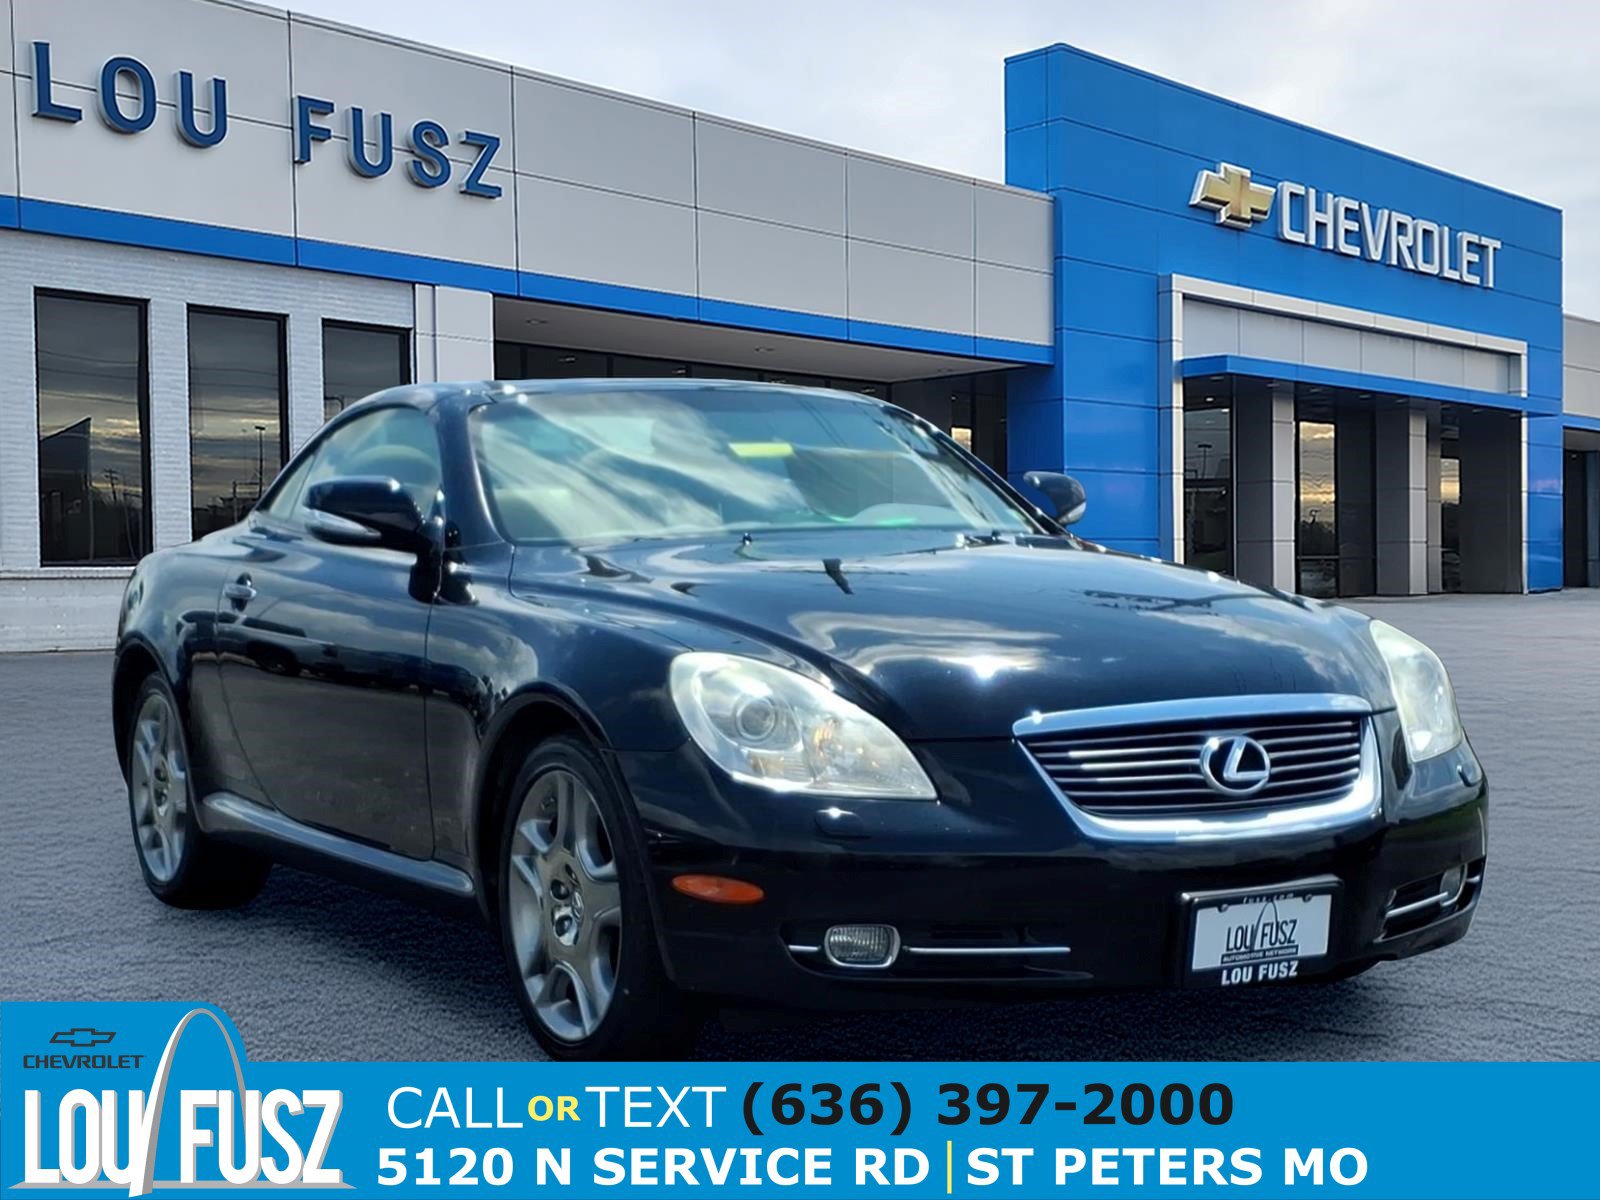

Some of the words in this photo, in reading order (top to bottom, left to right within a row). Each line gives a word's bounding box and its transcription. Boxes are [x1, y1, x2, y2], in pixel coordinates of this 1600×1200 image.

[32, 40, 227, 148] LOU
[293, 94, 502, 199] FUSZ
[1277, 180, 1501, 289] CHEVROLET
[1226, 924, 1254, 952] LOU
[1260, 919, 1298, 948] FUSZ
[1221, 965, 1253, 986] LOU
[1257, 960, 1299, 982] FUSZ
